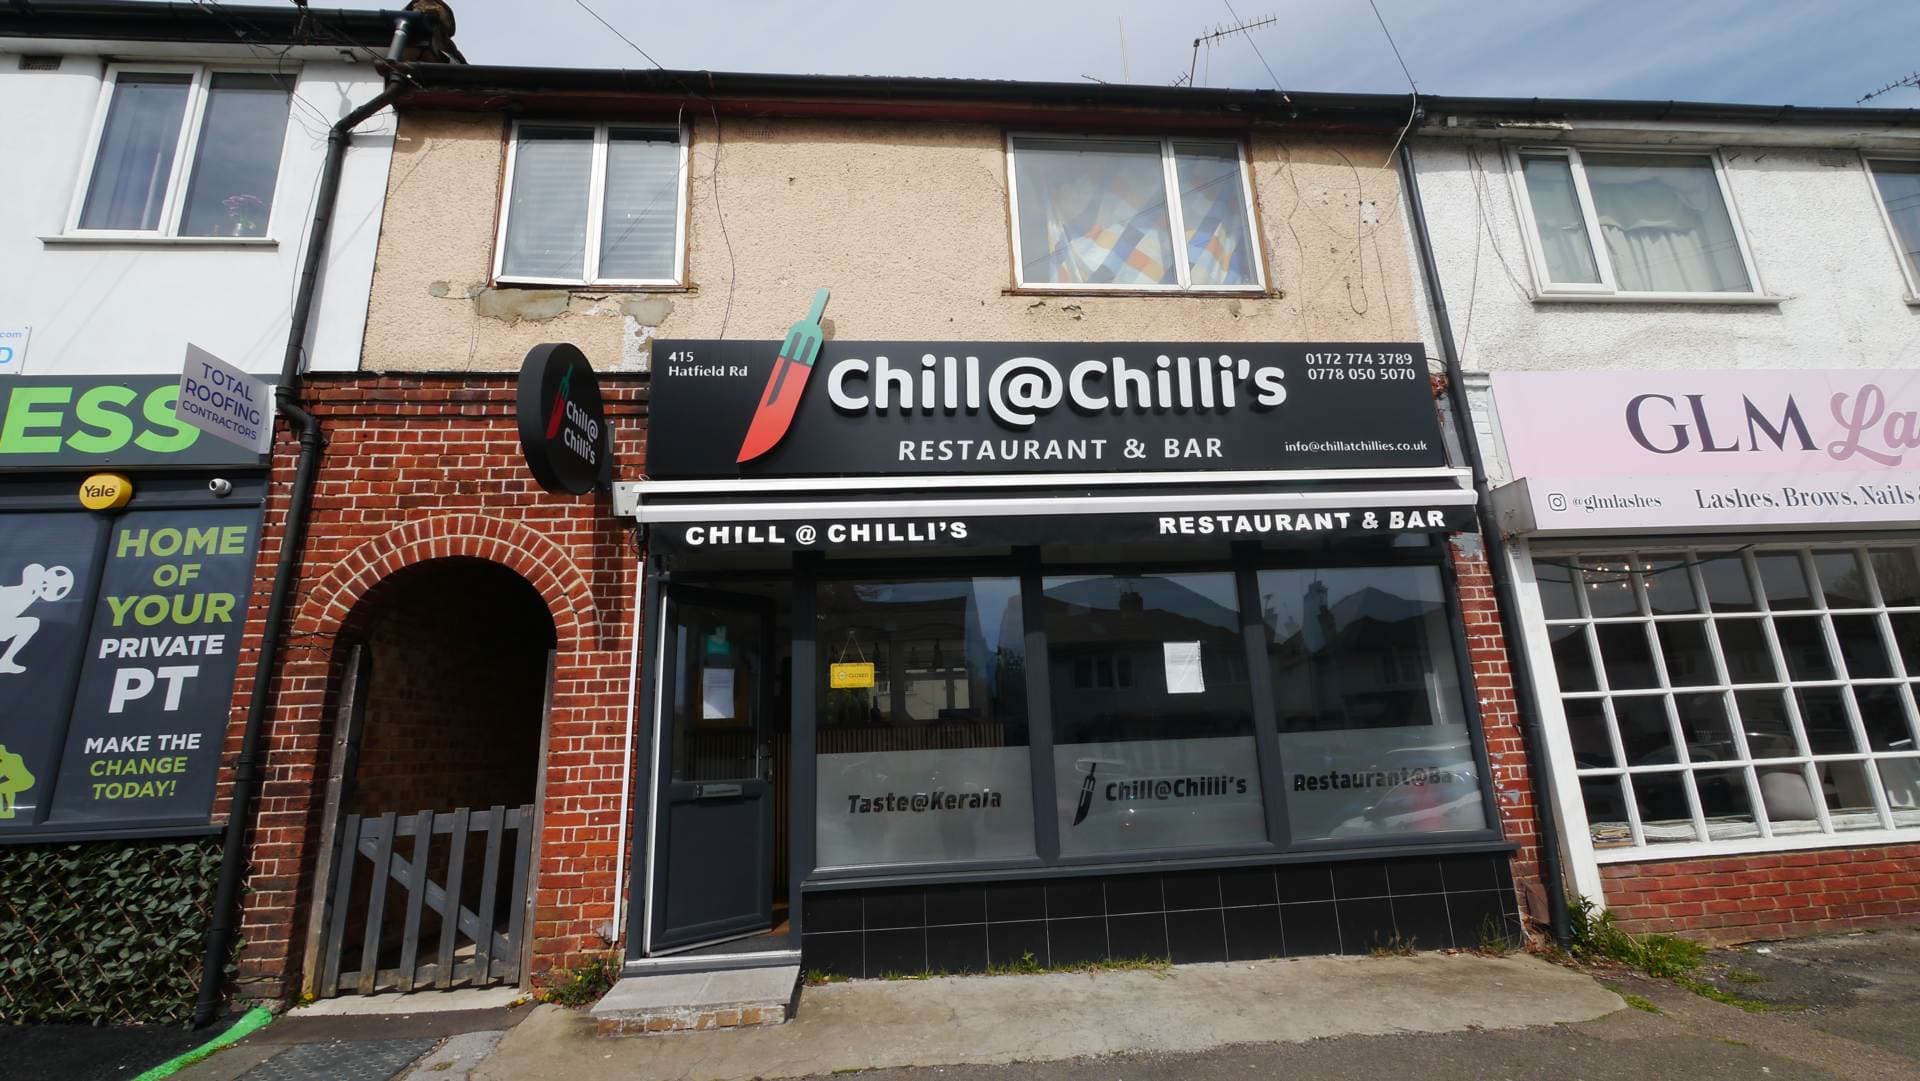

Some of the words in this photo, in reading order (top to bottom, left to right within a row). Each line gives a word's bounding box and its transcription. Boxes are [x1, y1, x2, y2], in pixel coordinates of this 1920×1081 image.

[668, 351, 694, 362] 415
[1305, 353, 1342, 365] 0172
[1346, 353, 1373, 365] 774
[1377, 353, 1413, 365] 3789
[202, 362, 253, 402] TOTAL
[668, 365, 725, 377] Hatfield
[729, 365, 748, 377] Rd
[1308, 368, 1345, 380] 0778
[1349, 368, 1376, 380] 050
[1380, 368, 1416, 380] 5070
[827, 354, 1287, 425] Chill@Chilli's
[185, 378, 260, 425] ROOFING
[182, 400, 257, 440] CONTRACTORS
[566, 400, 598, 443] Chill@
[1625, 392, 1823, 454] GLM
[564, 427, 596, 465] Chilli's
[899, 439, 1107, 461] RESTAURANT
[1123, 438, 1146, 459] &
[1164, 438, 1223, 458] BAR
[1284, 441, 1428, 452] info@chillatchillies.co.uk
[85, 485, 115, 498] Yale
[1694, 488, 1780, 509] Lashes,
[1859, 485, 1915, 505] Nails
[1573, 494, 1662, 513] @glmlashes
[1159, 513, 1350, 535] RESTAURANT
[1361, 511, 1379, 529] &
[1389, 510, 1446, 529] BAR
[116, 526, 248, 557] HOME
[685, 526, 785, 545] CHILL
[796, 525, 816, 545] @
[153, 564, 201, 587] OF
[106, 592, 236, 627] YOUR
[98, 634, 225, 659] PRIVATE
[108, 665, 200, 713] PT
[84, 736, 151, 754] MAKE
[158, 733, 202, 751] THE
[90, 756, 188, 776] CHANGE
[92, 780, 177, 800] TODAY!
